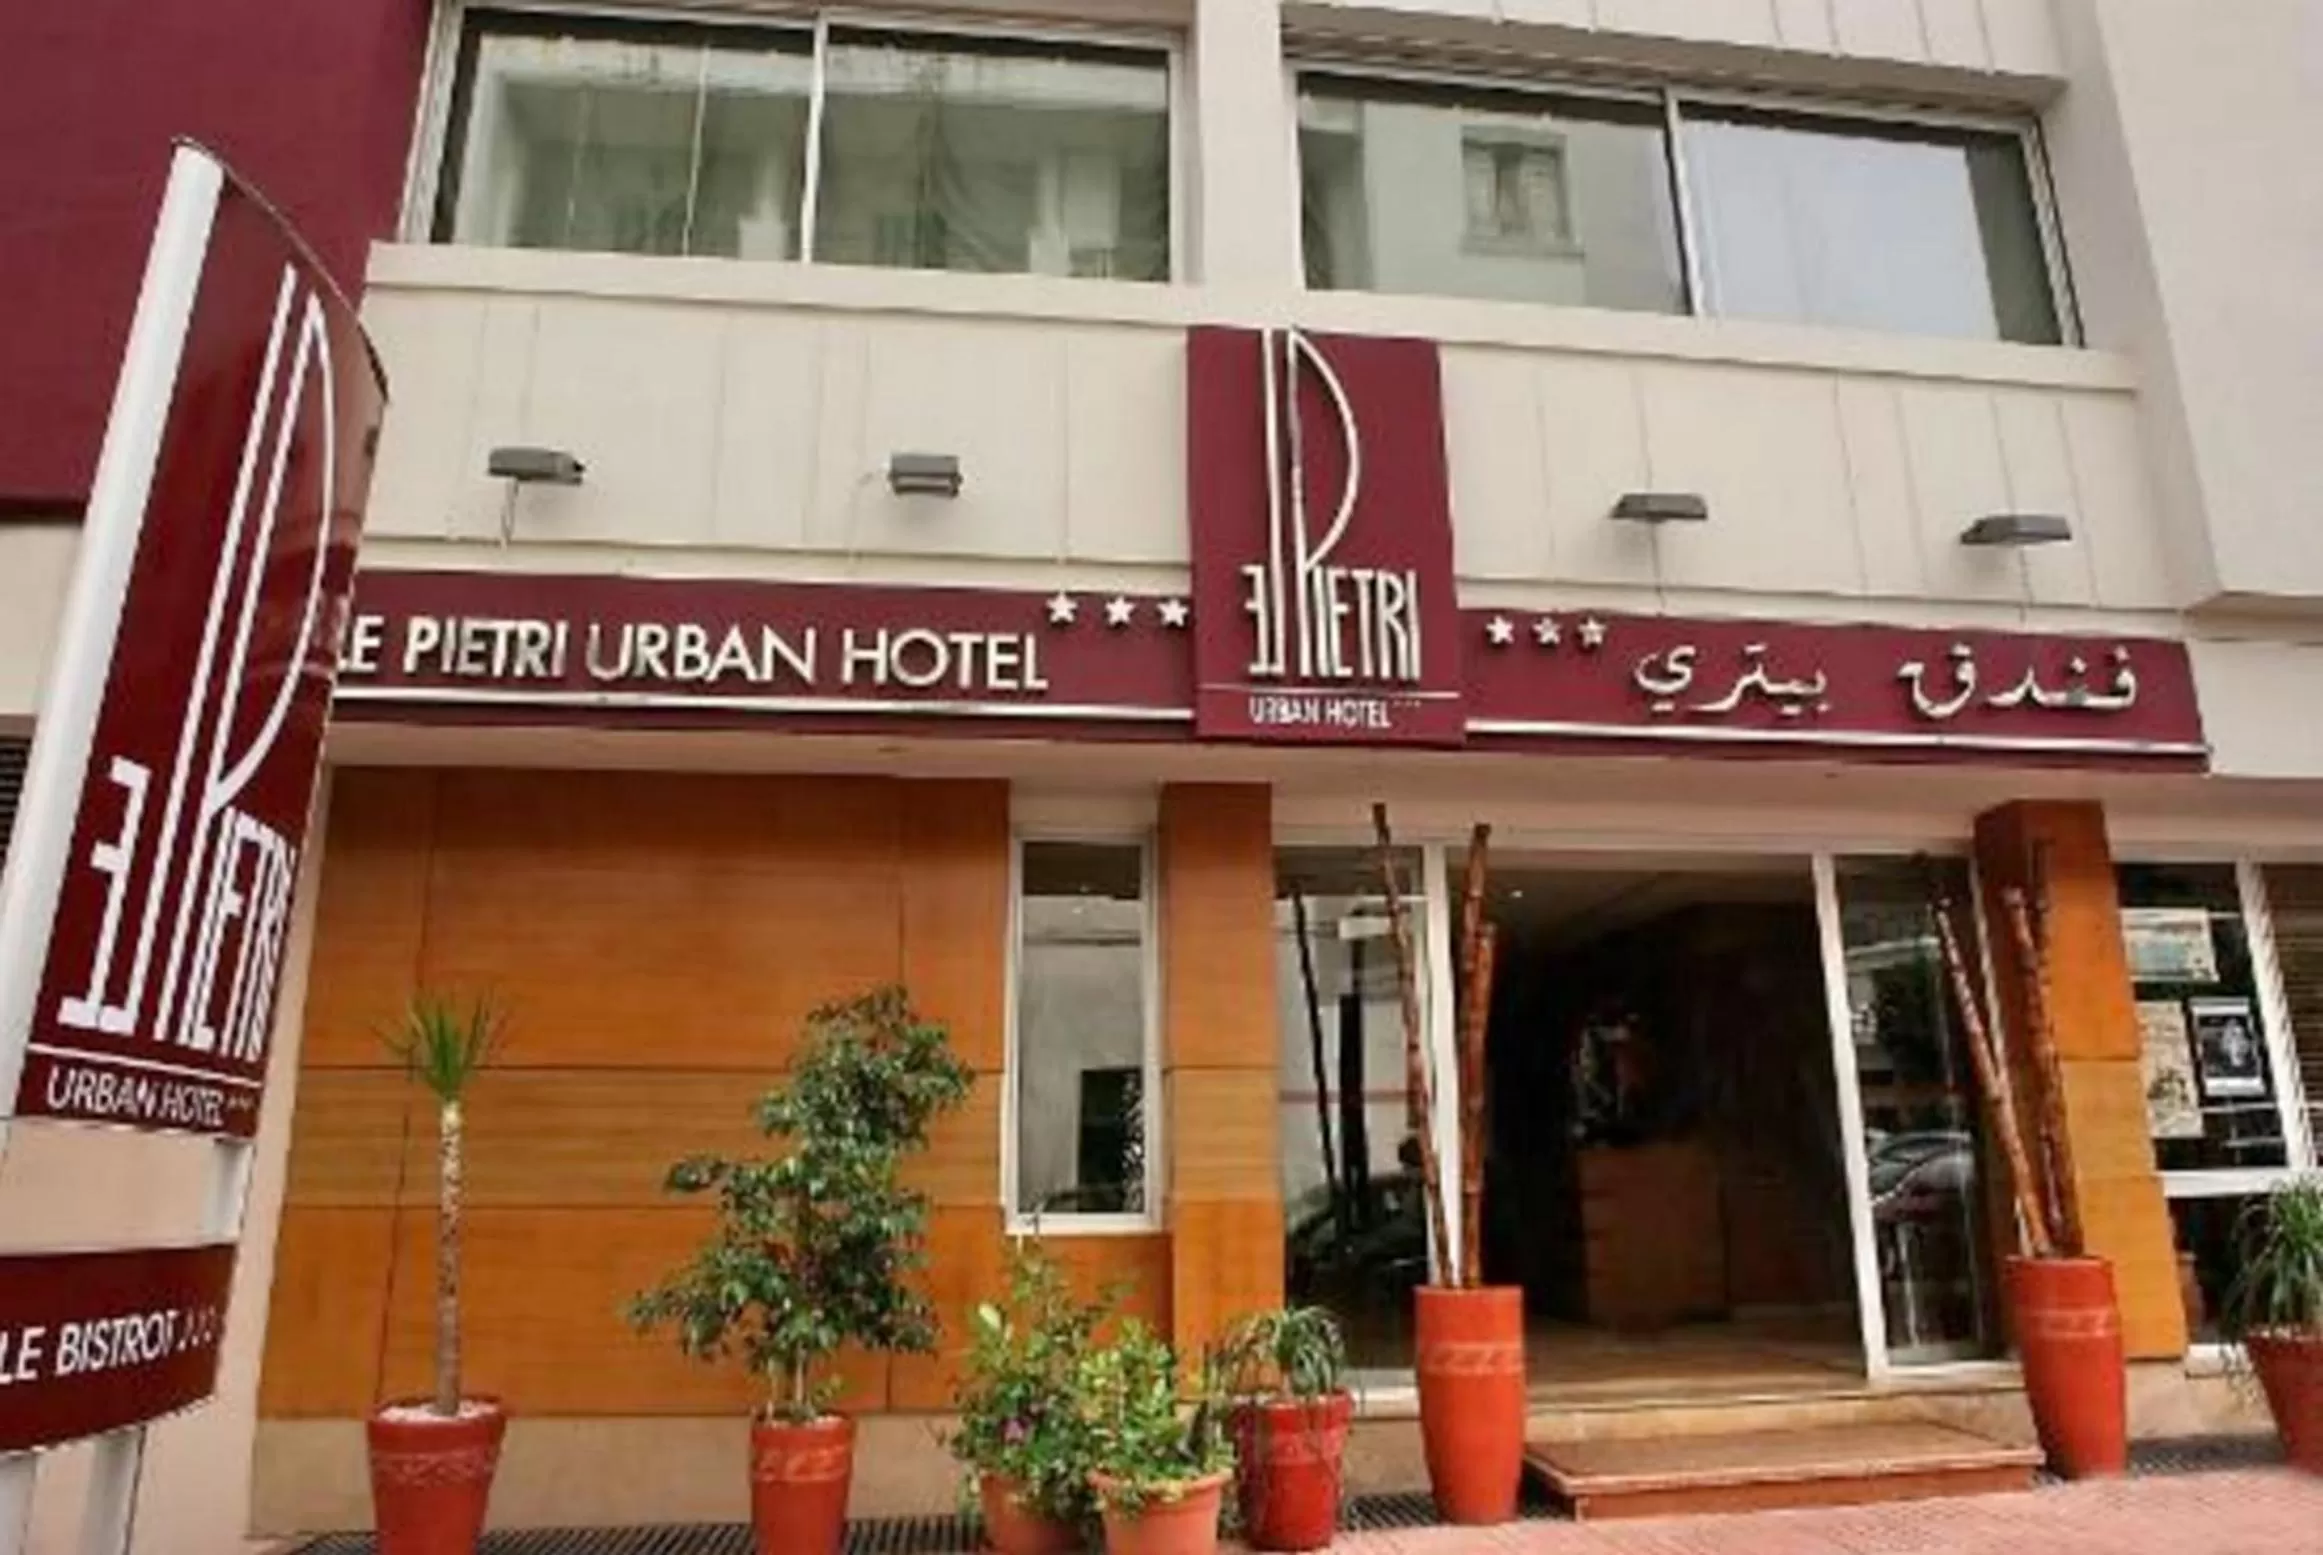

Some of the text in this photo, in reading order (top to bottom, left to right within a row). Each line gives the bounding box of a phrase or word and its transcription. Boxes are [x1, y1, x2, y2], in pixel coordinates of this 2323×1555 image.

[337, 616, 1049, 690] E PIETRI URBAN HOTEL
[1633, 641, 2139, 719] فندق بيتري
[1249, 696, 1392, 728] URBAN HOTEL
[47, 1065, 155, 1117] URBAN
[0, 1326, 46, 1384] LE
